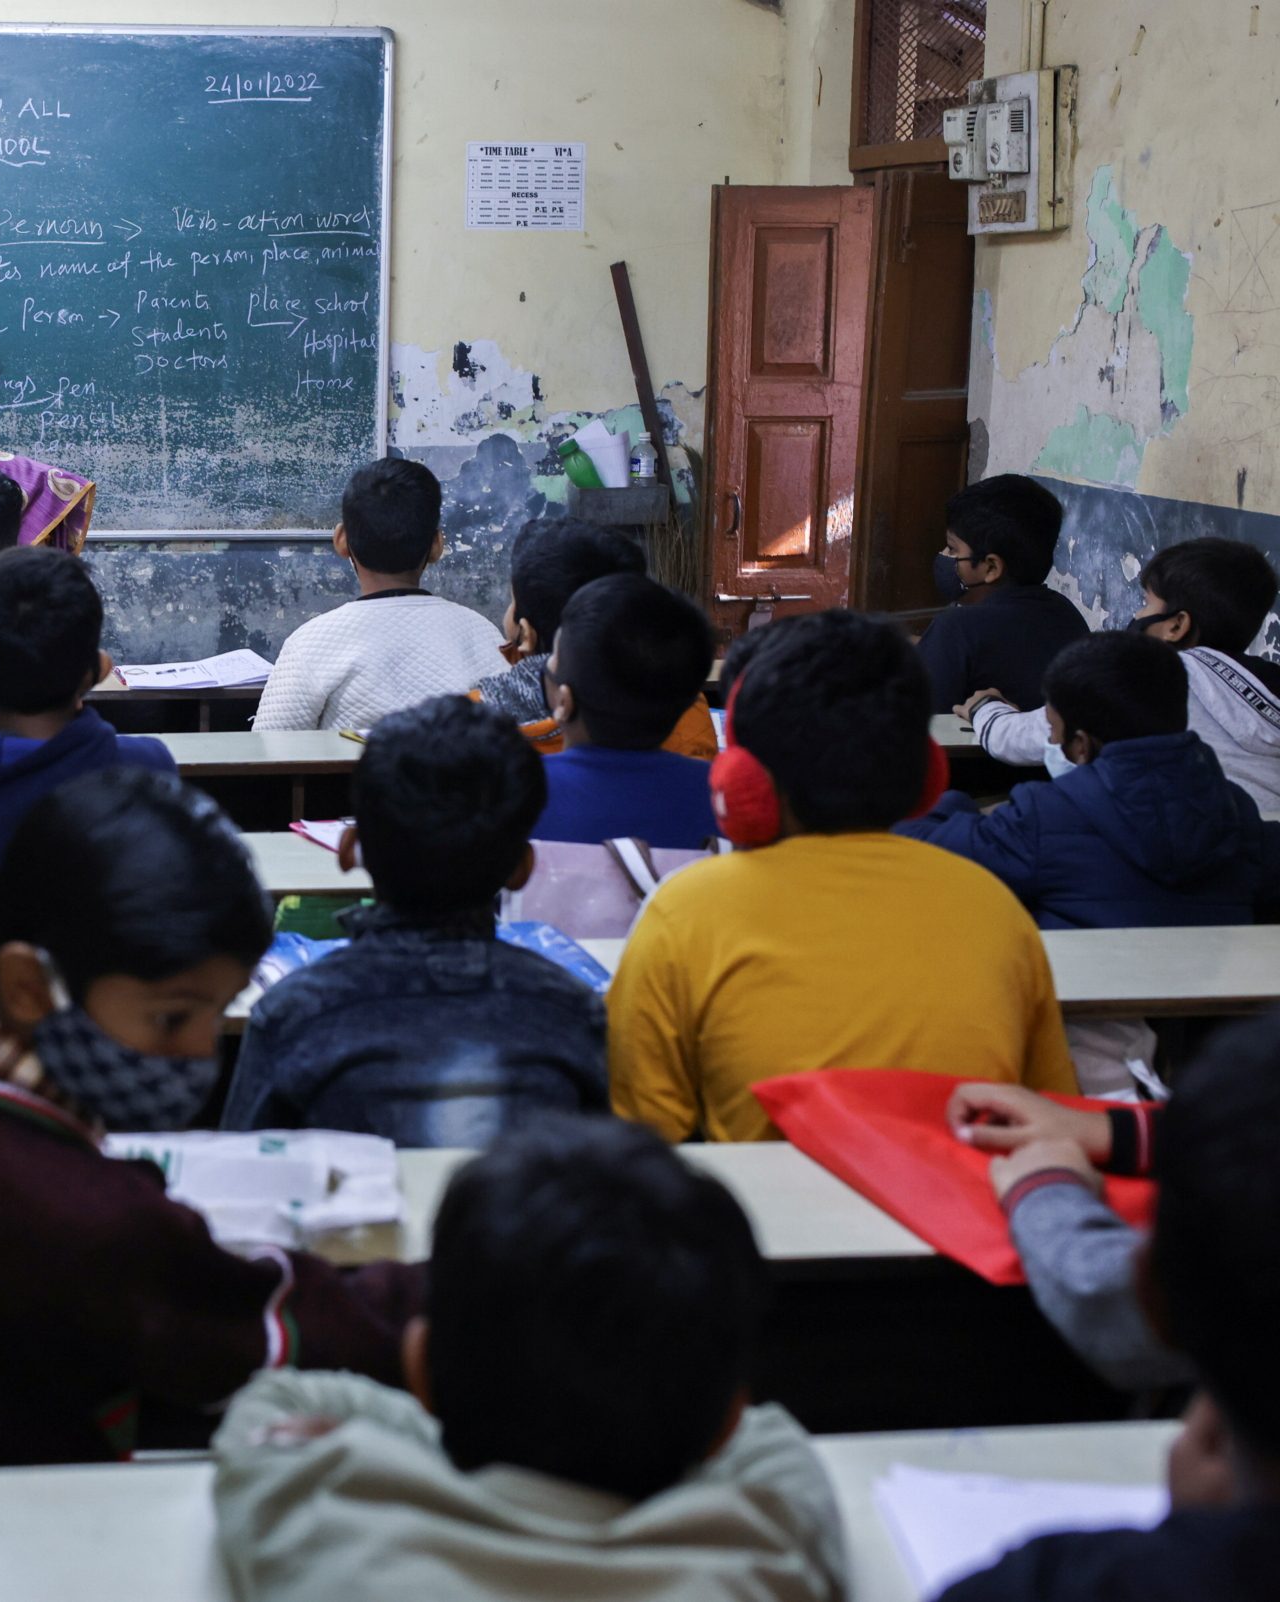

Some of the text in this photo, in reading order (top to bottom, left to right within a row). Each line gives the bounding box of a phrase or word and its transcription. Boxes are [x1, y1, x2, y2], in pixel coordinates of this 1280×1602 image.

[18, 97, 71, 120] ALL
[484, 146, 502, 156] TIME
[504, 147, 528, 157] TABLE
[316, 205, 371, 230] word
[40, 263, 101, 278] name
[107, 251, 133, 279] of
[140, 250, 178, 273] the
[131, 317, 228, 348] Students
[303, 328, 378, 363] Hospital
[294, 369, 354, 397] Home
